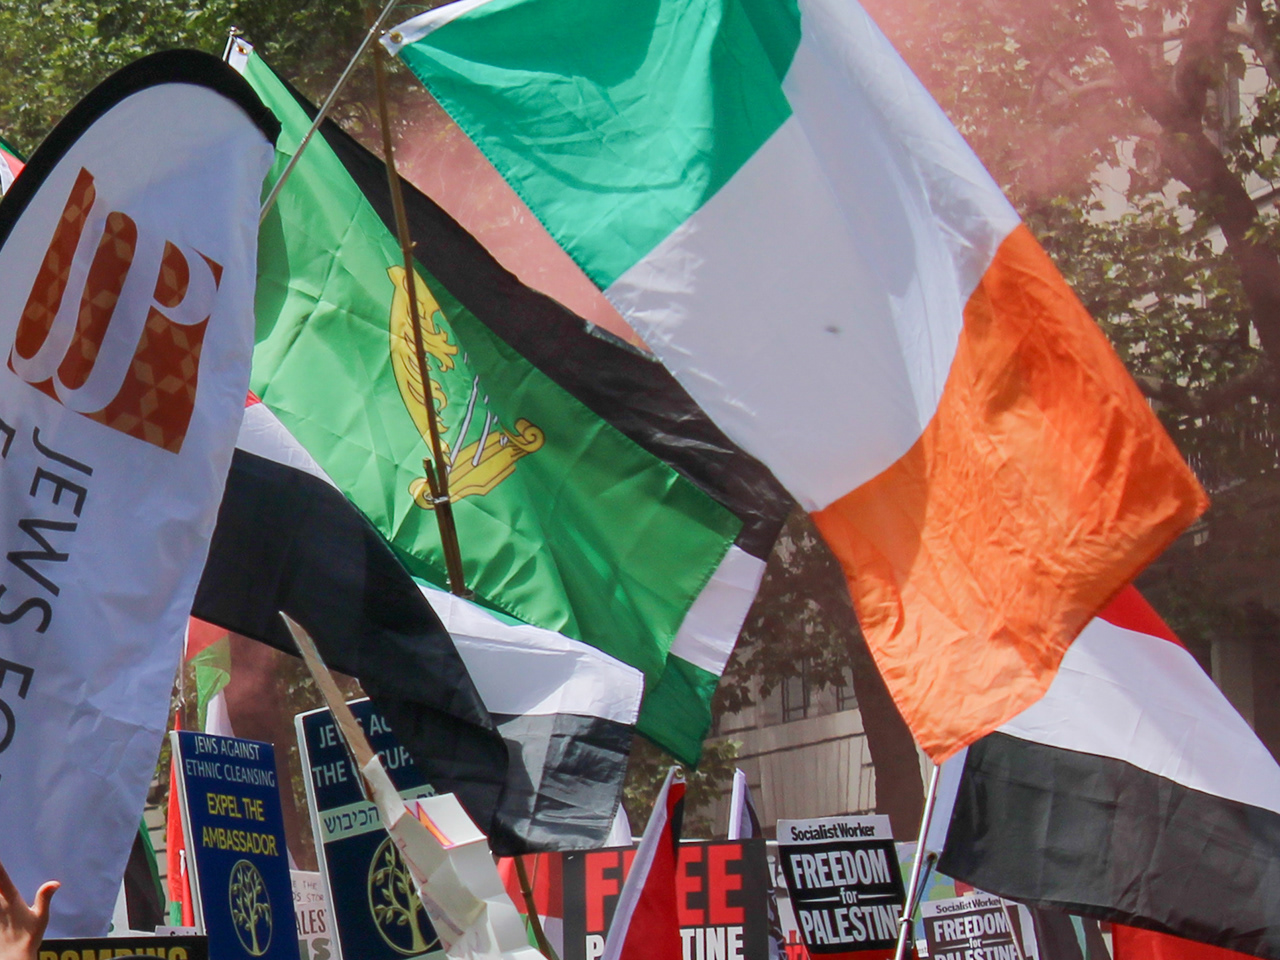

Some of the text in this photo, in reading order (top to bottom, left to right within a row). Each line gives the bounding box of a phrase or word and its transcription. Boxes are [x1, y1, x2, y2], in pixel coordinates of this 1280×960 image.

[195, 735, 260, 760] JEWS AGAINST
[319, 717, 365, 748] JE
[185, 758, 275, 788] ETHNIC CLEANSING
[312, 760, 347, 788] THE
[206, 792, 265, 821] EXPEL THE
[324, 805, 380, 835] הכיבוש
[202, 825, 279, 857] AMBASSADOR
[790, 849, 892, 889] FREEDOM
[585, 843, 746, 933] FEE
[839, 887, 858, 904] for
[933, 911, 1010, 943] FREEDOM
[968, 937, 983, 949] for
